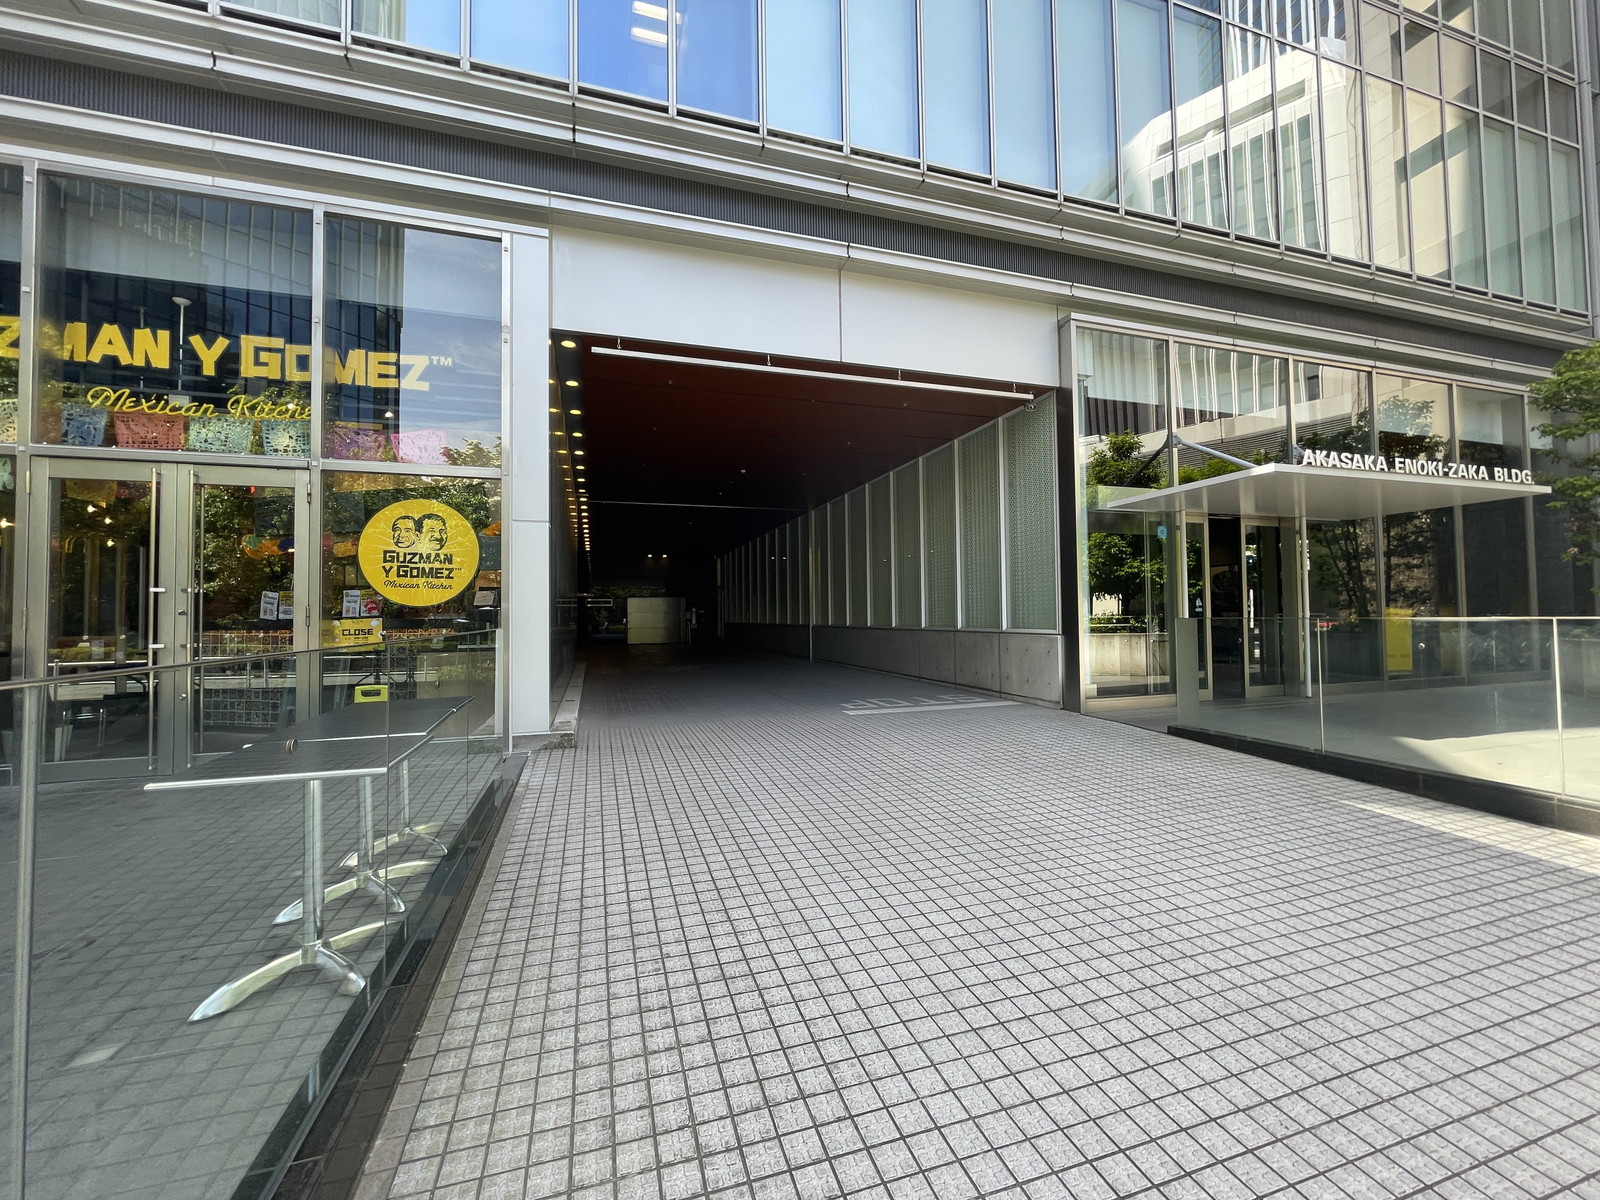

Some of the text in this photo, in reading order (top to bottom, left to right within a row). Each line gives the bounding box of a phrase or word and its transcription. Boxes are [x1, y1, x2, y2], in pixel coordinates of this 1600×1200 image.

[188, 334, 230, 376] Y
[87, 386, 312, 419] Mexican Kitche
[1303, 448, 1536, 485] AKASAKA ENOKI-ZAKA BLDG.
[382, 549, 454, 565] GUZMAN
[381, 565, 394, 578] Y
[383, 580, 454, 591] Mexican Kitchen
[341, 628, 374, 636] CLOSE
[840, 694, 987, 709] STOP
